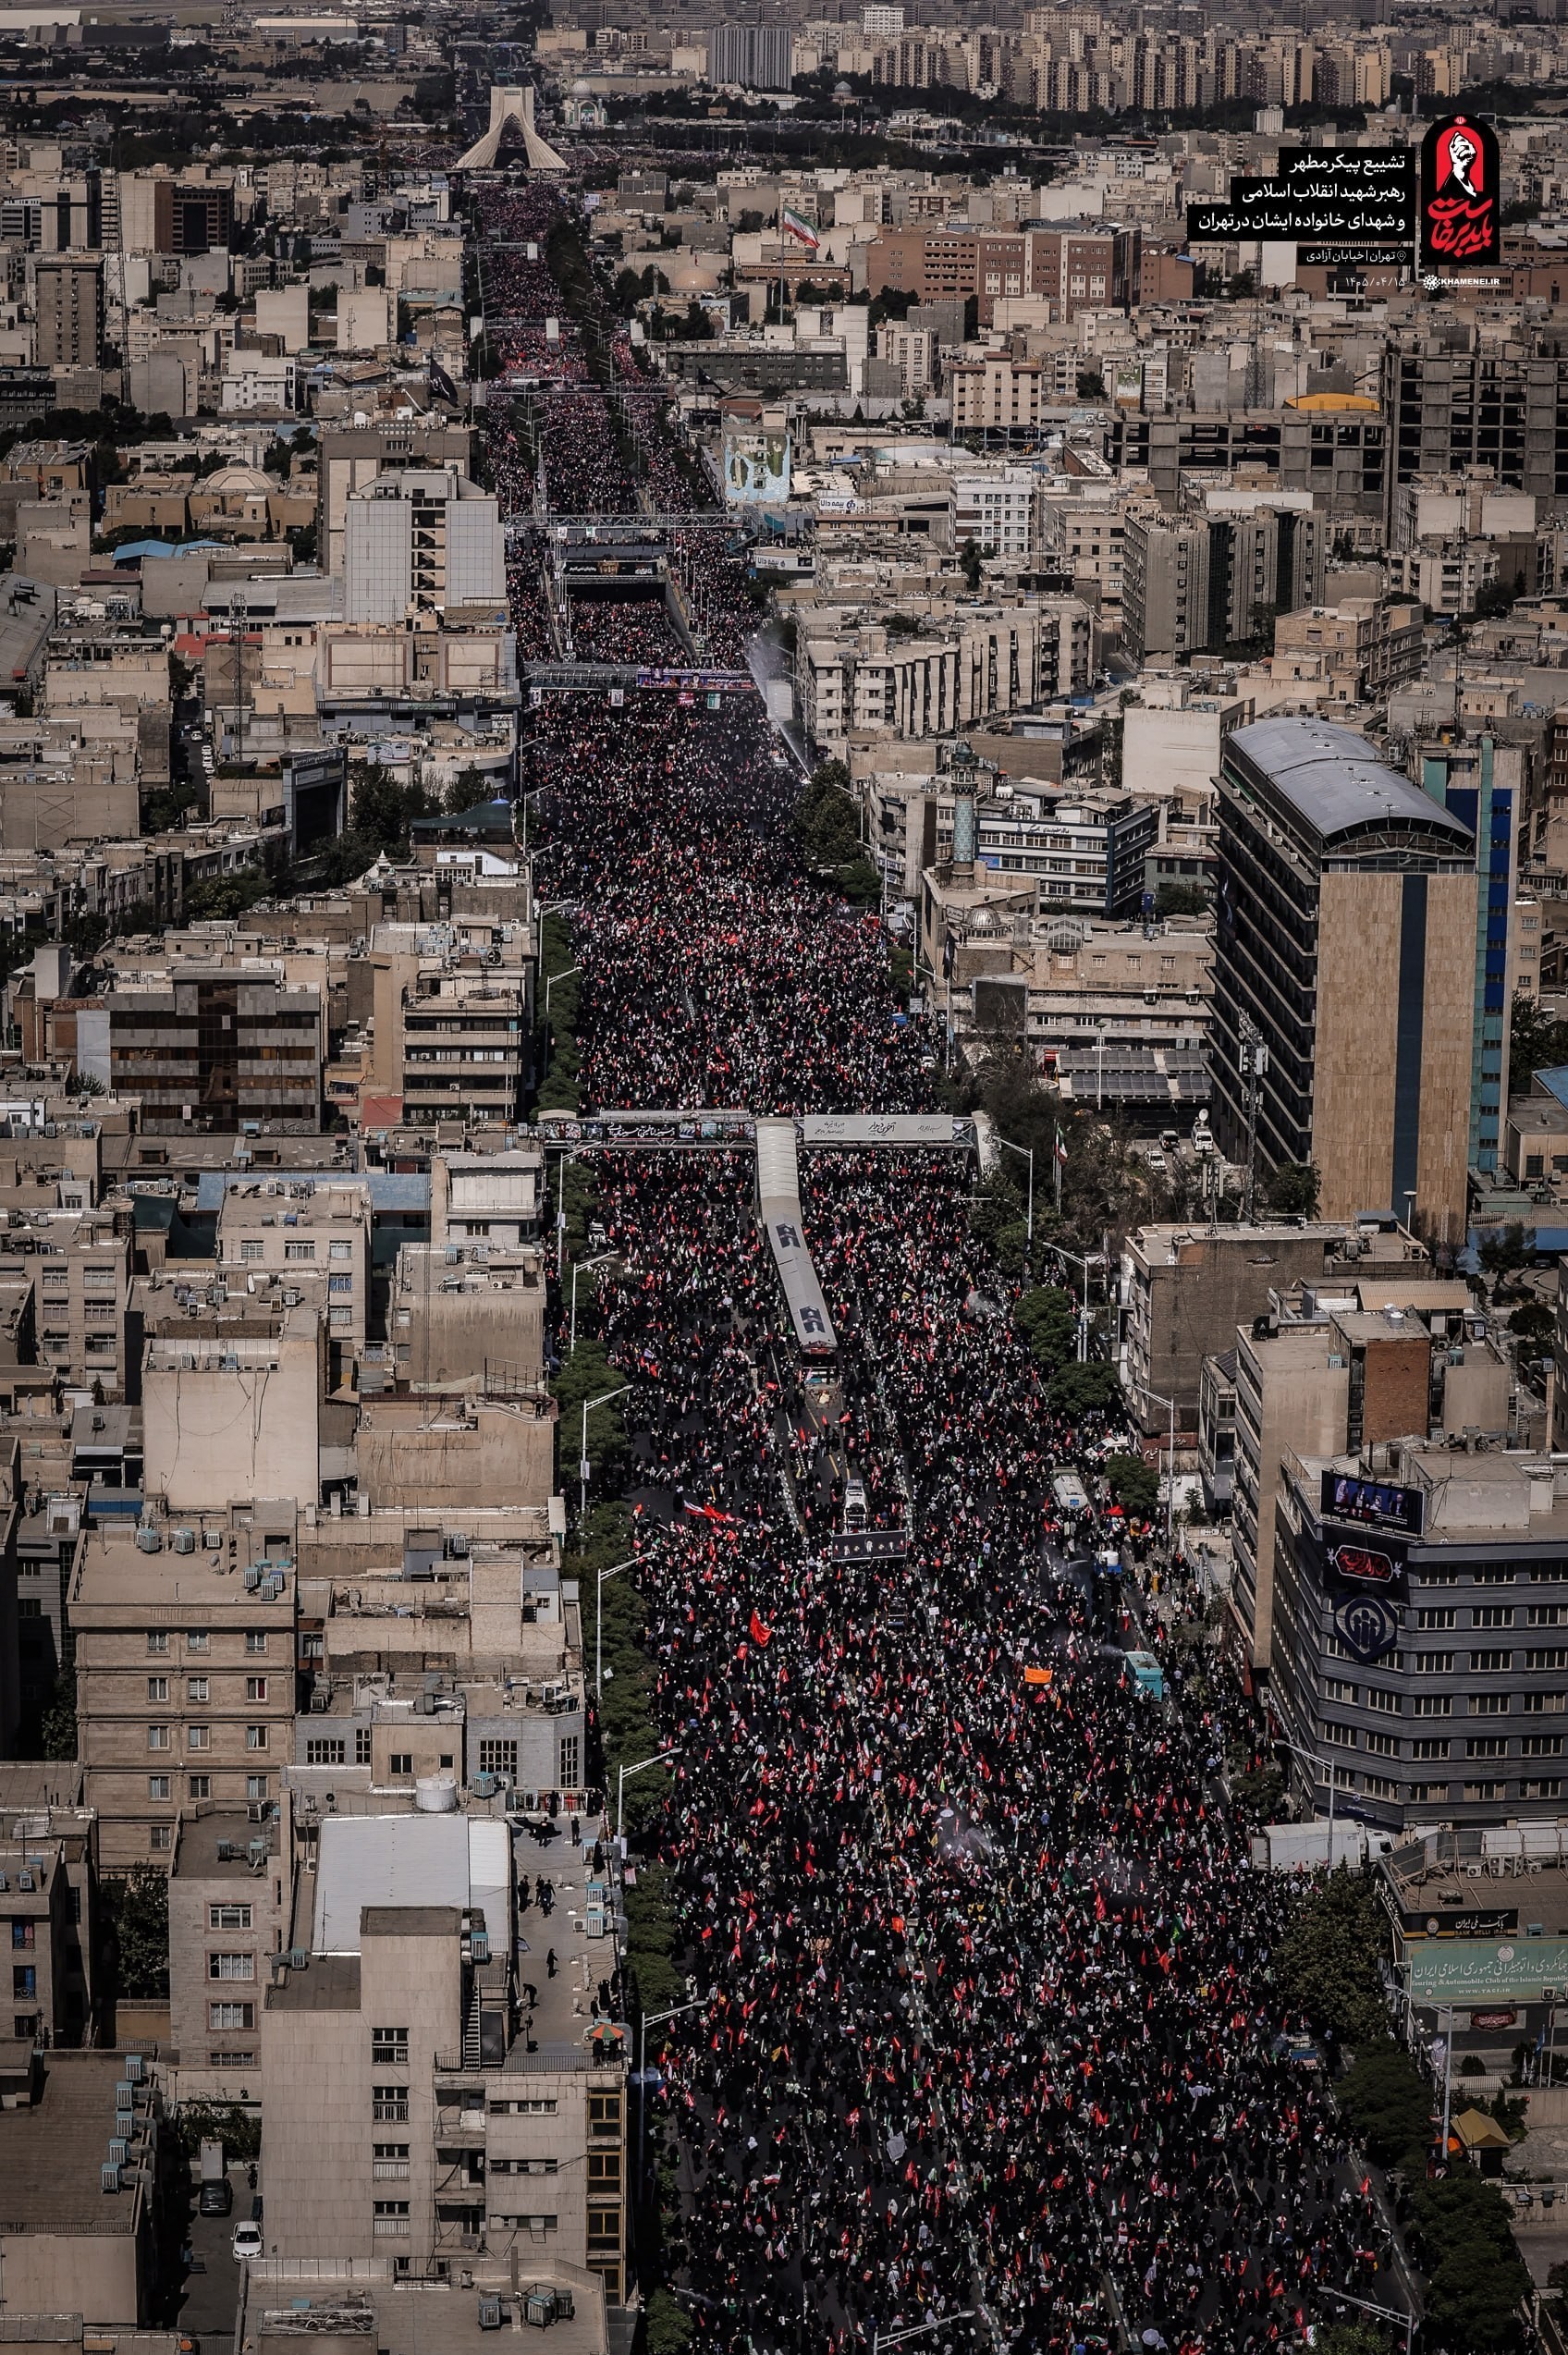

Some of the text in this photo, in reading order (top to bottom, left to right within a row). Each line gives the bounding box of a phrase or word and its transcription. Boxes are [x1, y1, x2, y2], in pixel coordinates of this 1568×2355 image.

[1455, 1913, 1509, 1930] بانک ملی ایران
[1414, 1963, 1438, 1979] ایران
[1439, 1963, 1464, 1977] اسلامی
[1464, 1960, 1493, 1977] جمهوری
